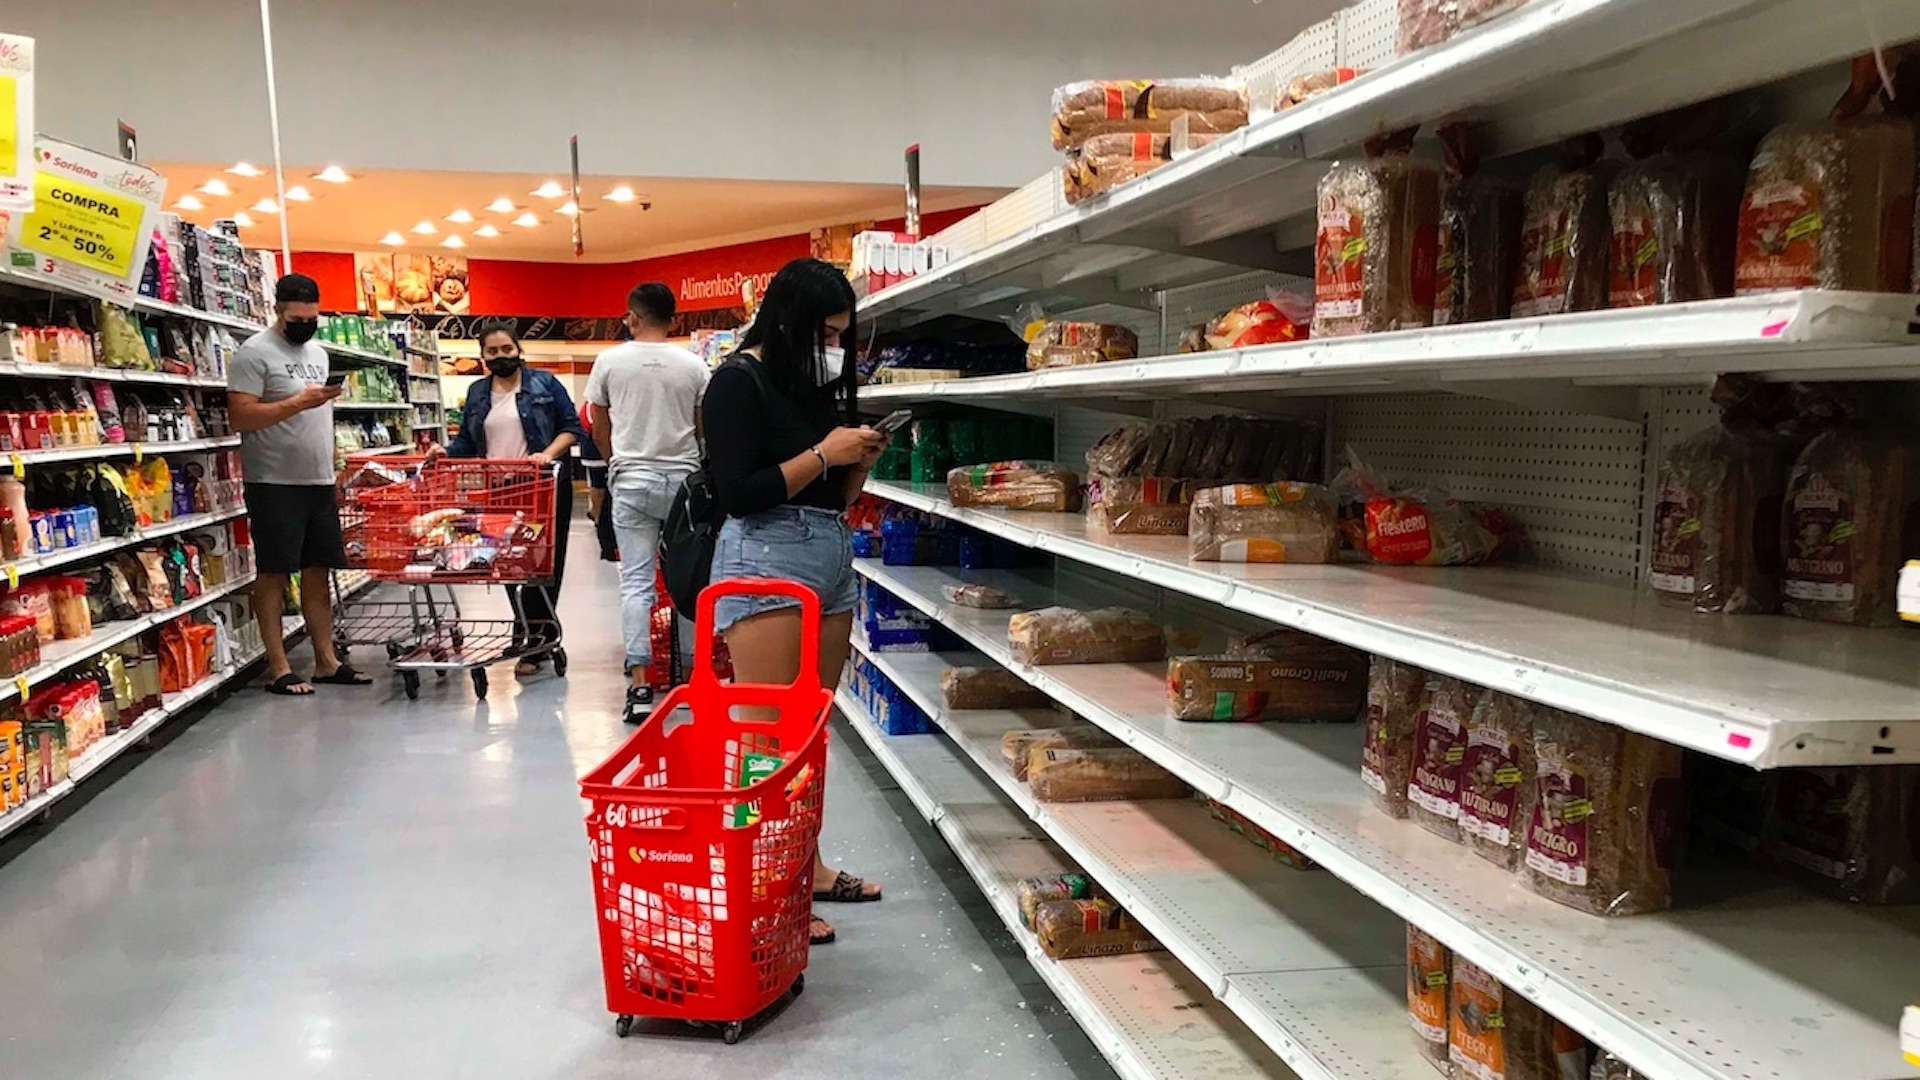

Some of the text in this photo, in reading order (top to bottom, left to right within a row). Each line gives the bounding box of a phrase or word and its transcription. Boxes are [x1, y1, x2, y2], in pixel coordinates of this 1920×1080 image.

[53, 157, 98, 179] Soriana
[51, 189, 119, 218] COMPRA
[73, 237, 115, 261] 50%
[1210, 667, 1244, 679] GRANOS
[1244, 664, 1254, 682] 5
[605, 803, 627, 828] 60
[648, 849, 693, 863] Soriana
